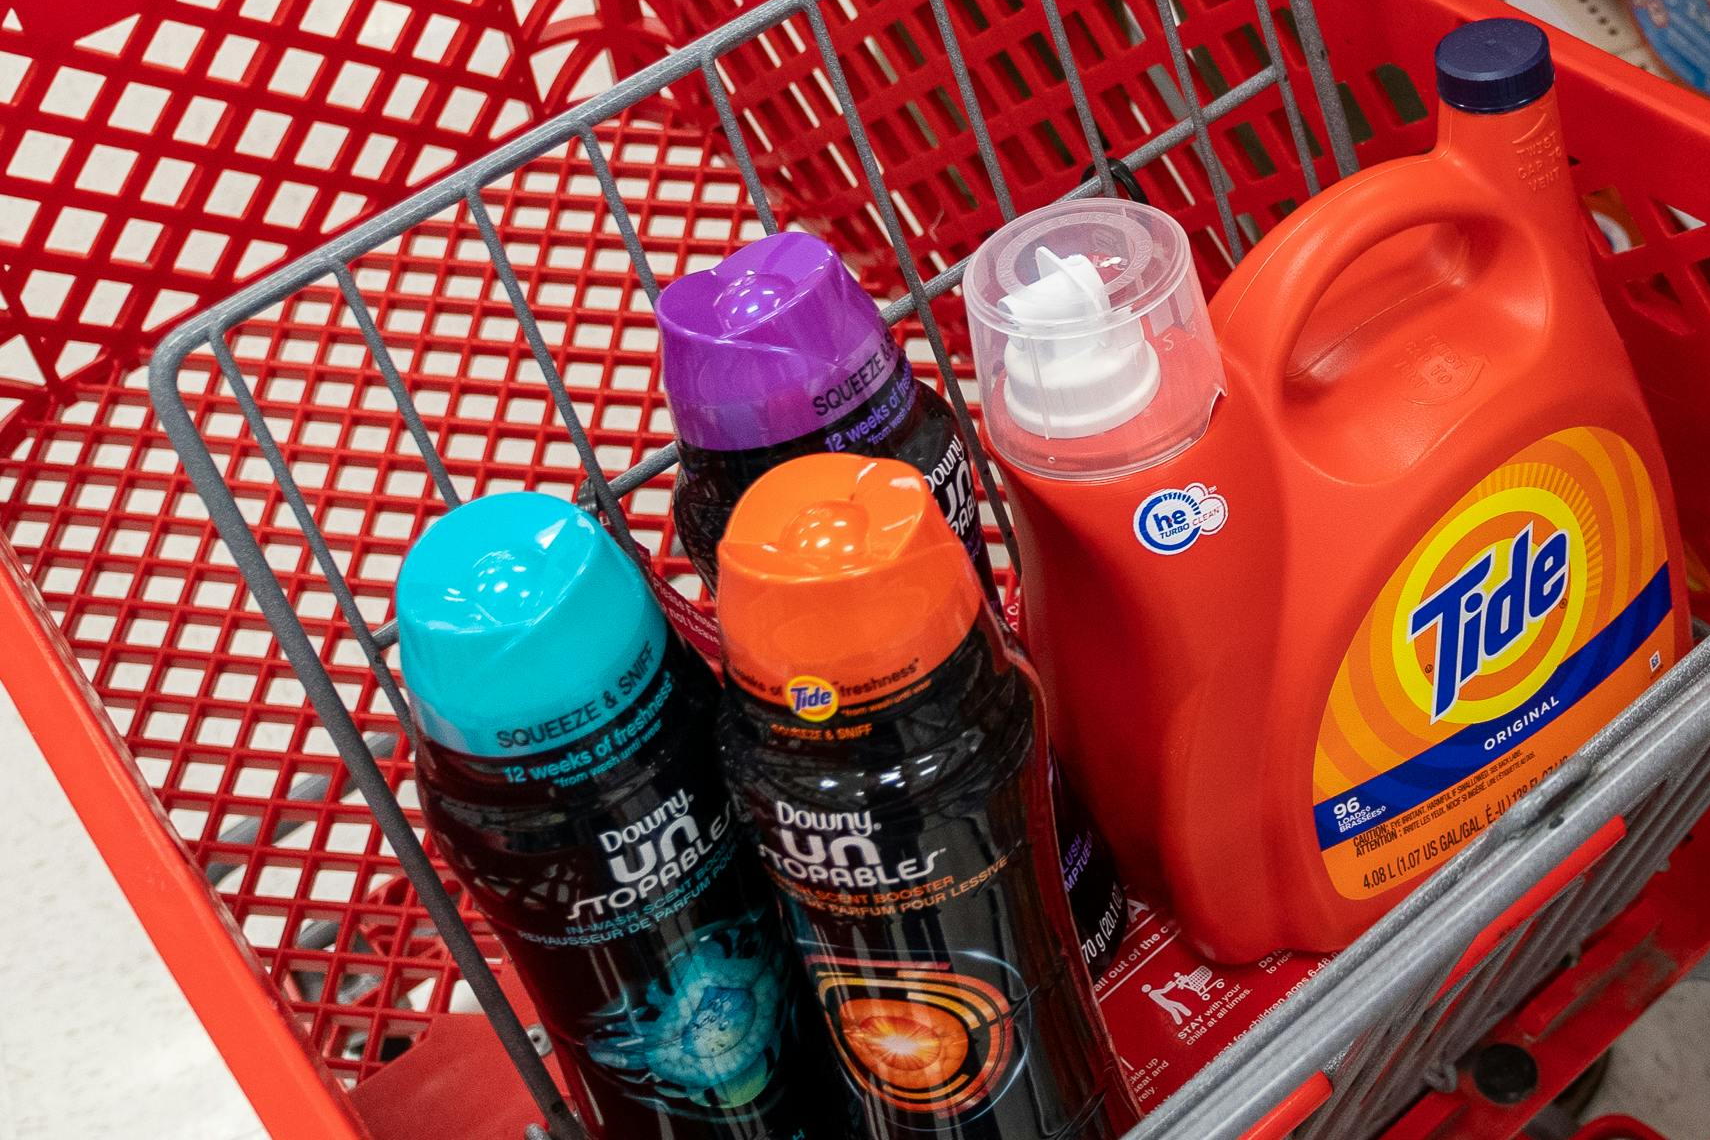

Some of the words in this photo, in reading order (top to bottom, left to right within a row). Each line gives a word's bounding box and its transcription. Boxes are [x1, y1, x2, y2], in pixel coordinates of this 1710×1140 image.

[813, 351, 885, 415] SQUEEZE
[825, 432, 845, 453] 12
[847, 404, 890, 443] weeks
[1153, 510, 1186, 531] he
[1160, 523, 1190, 539] TURBO
[1193, 507, 1220, 527] CLEAN
[1408, 522, 1569, 726] Tide
[496, 701, 601, 749] SQUEEZE
[604, 691, 618, 709] &
[618, 640, 655, 695] SNIFF
[791, 687, 832, 710] Tide
[1484, 695, 1559, 751] ORIGINAL
[504, 766, 526, 784] 12
[529, 750, 593, 780] weeks
[594, 736, 613, 757] of
[600, 789, 689, 853] Downy
[776, 800, 872, 836] Downy
[1334, 797, 1360, 819] 96
[609, 815, 700, 883] un
[781, 831, 881, 866] un
[1353, 824, 1390, 847] CAUTION:
[1356, 831, 1398, 858] ATTENTION
[902, 894, 947, 913] POUR
[951, 856, 1008, 898] LESSIVE
[1364, 864, 1386, 889] 4.08
[1389, 862, 1396, 878] L
[1397, 849, 1421, 876] (1.07
[1424, 841, 1439, 861] US
[566, 911, 638, 935] IN-WASH
[642, 879, 693, 912] SCENT
[628, 919, 652, 934] DE
[654, 879, 711, 924] PARFUM
[874, 876, 954, 904] BOOSTER
[1109, 962, 1128, 979] out
[1129, 949, 1139, 961] of
[1140, 935, 1160, 951] the
[1177, 1012, 1205, 1040] STAY
[1204, 1002, 1225, 1019] with
[1223, 983, 1243, 1003] your
[1186, 1023, 1206, 1046] child
[1207, 1015, 1216, 1028] at
[1215, 1007, 1227, 1021] all
[1225, 987, 1252, 1012] times.
